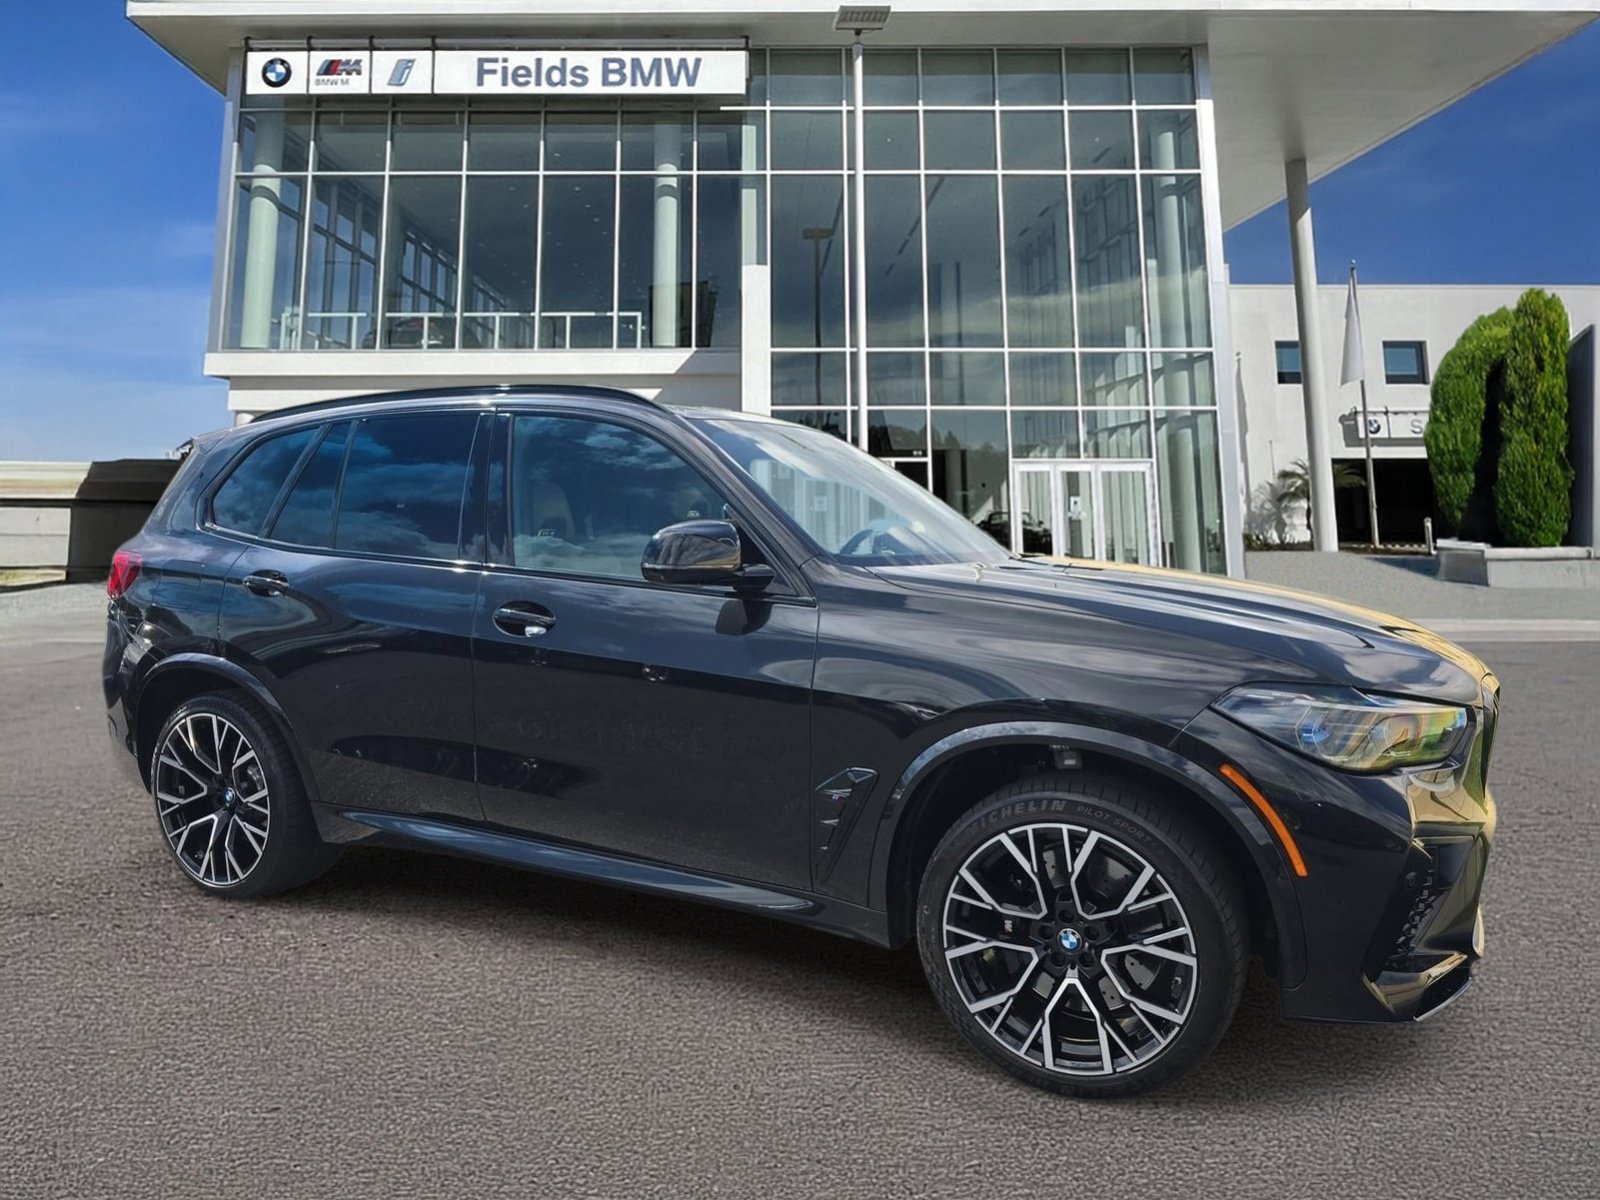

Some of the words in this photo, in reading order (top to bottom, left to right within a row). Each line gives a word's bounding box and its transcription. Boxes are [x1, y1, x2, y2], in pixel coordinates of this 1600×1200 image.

[476, 57, 589, 88] Fields
[601, 57, 702, 88] BMW
[1077, 806, 1111, 821] PILOT
[1113, 817, 1152, 843] SPORT
